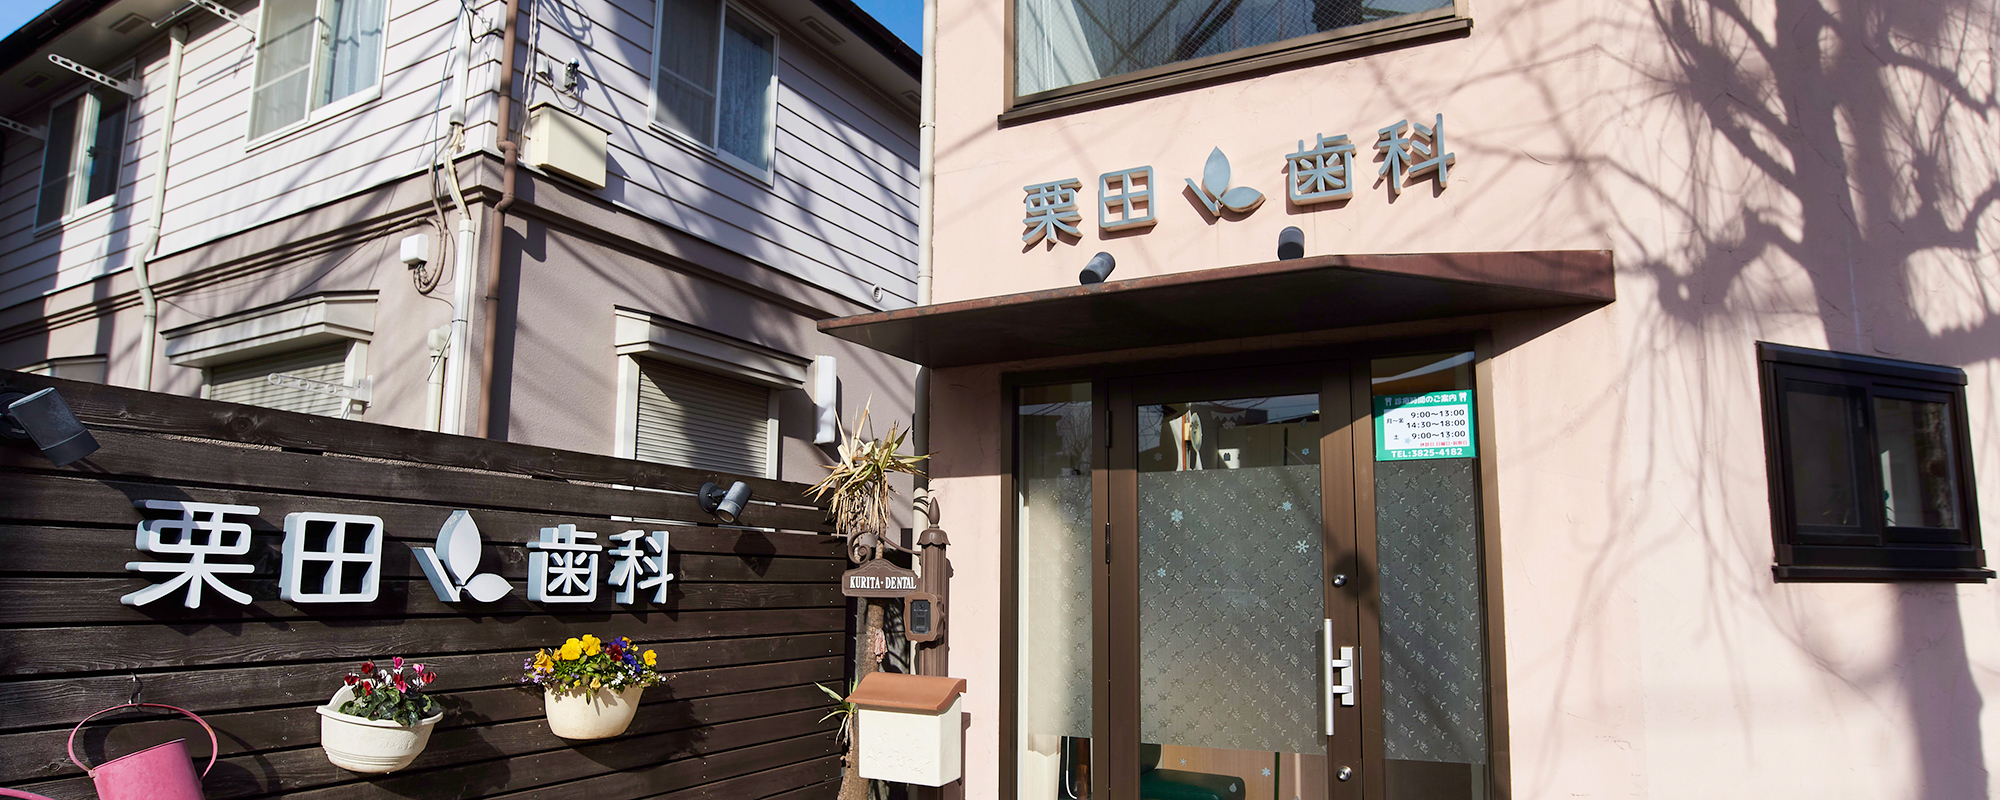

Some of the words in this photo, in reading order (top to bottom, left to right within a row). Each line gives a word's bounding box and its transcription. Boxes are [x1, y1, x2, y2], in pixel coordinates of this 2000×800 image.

[1022, 165, 1158, 245] 栗田
[1285, 112, 1455, 206] 歯科
[1410, 409, 1465, 419] 9:00〜13:00
[1406, 419, 1466, 429] 14:30〜18:00
[1411, 430, 1466, 440] 9:00〜13:00
[1391, 448, 1463, 458] TEL:3825-4182
[121, 500, 384, 608] 栗田
[526, 524, 674, 604] 歯科
